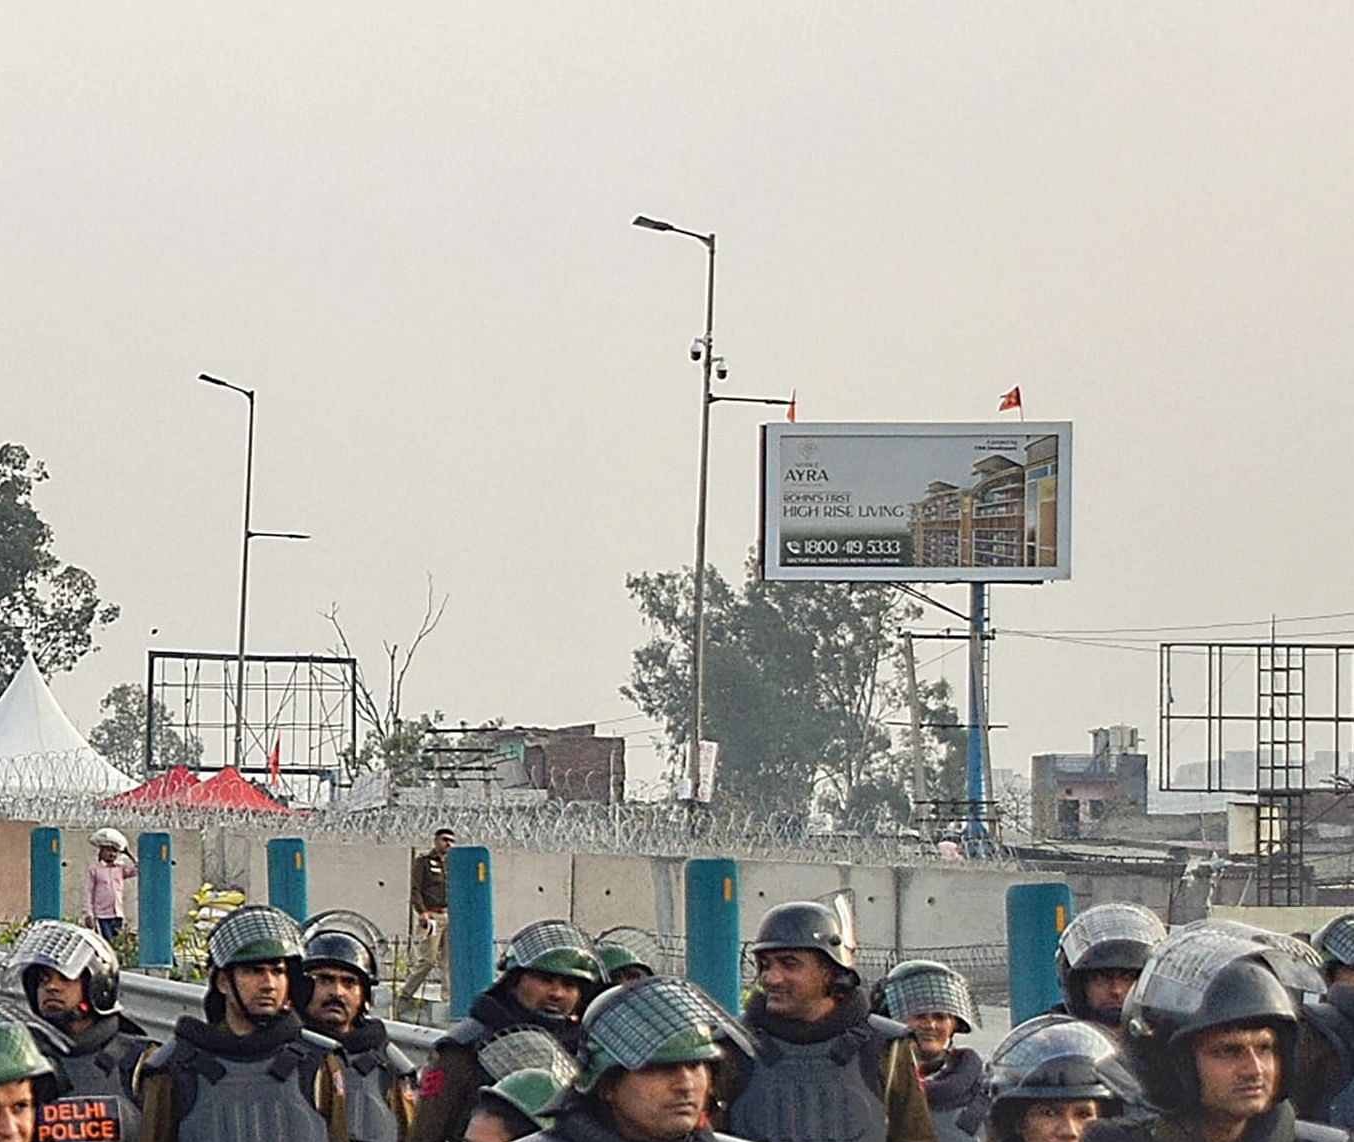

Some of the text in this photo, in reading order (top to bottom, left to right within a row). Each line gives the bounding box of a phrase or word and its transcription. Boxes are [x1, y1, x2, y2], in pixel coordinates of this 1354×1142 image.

[783, 469, 829, 482] AYRA
[783, 505, 905, 518] HIGH RISE LIVING
[804, 540, 901, 554] 1800 419 5333
[42, 1102, 106, 1122] DELHI
[38, 1119, 114, 1142] POLICE
